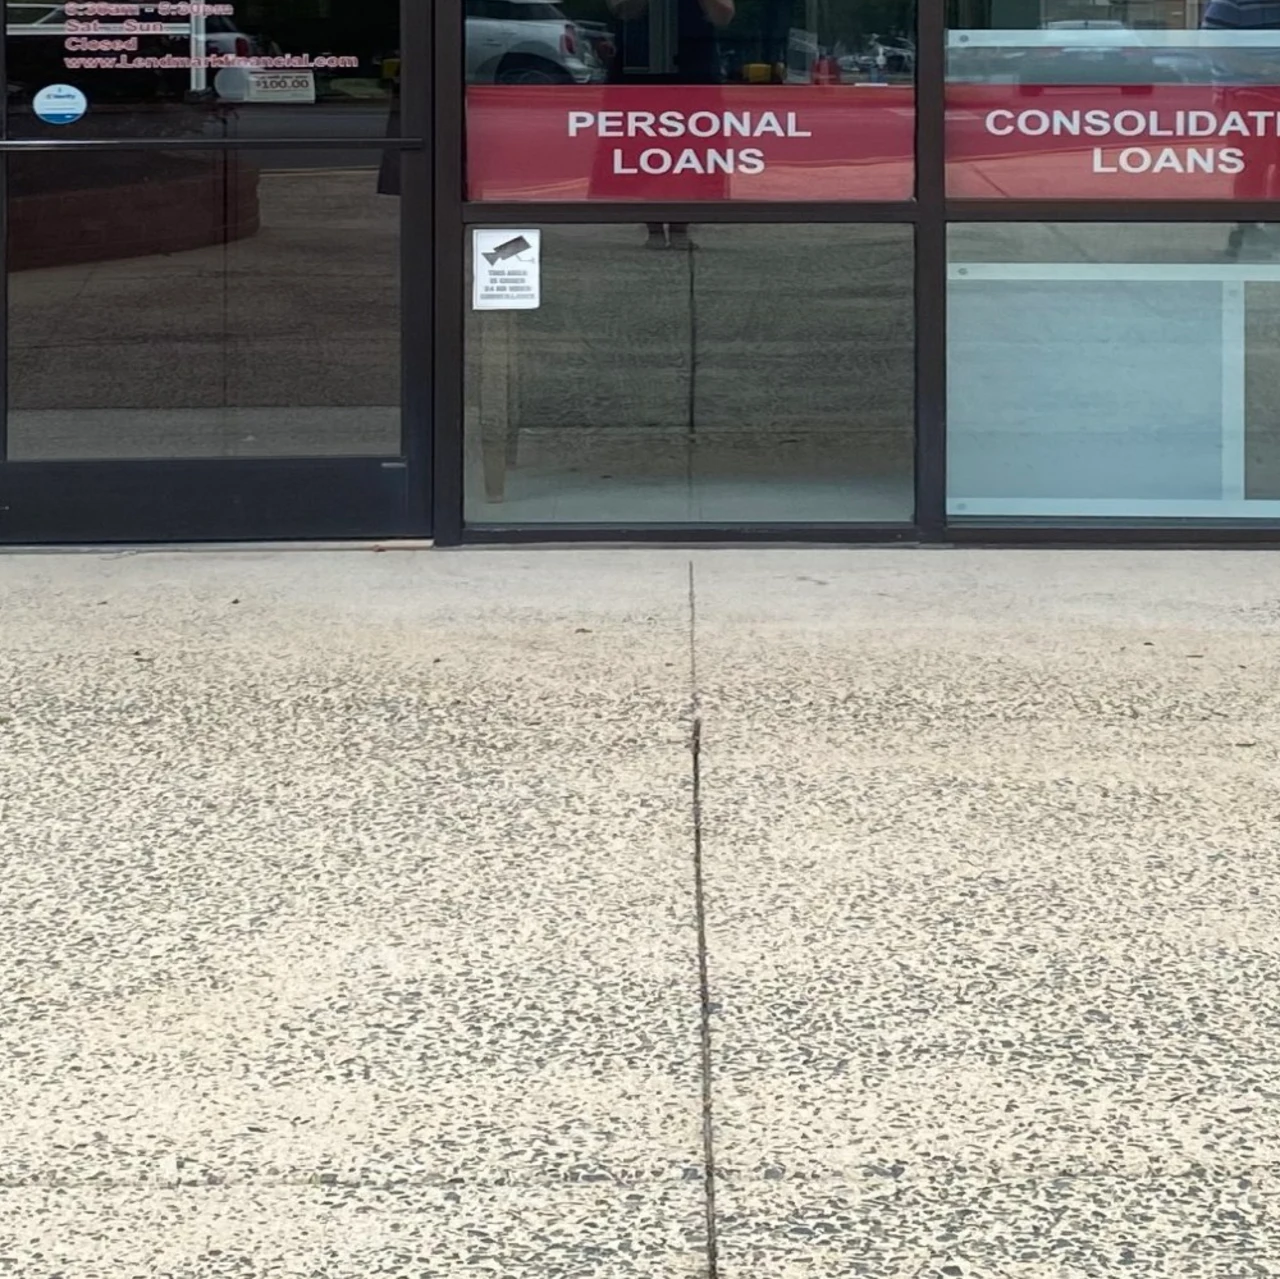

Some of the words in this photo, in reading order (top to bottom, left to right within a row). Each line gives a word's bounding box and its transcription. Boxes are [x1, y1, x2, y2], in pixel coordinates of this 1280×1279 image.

[64, 37, 138, 51] Closed
[568, 111, 812, 138] PERSONAL
[613, 148, 765, 175] LOANS
[1092, 147, 1245, 175] LOANS
